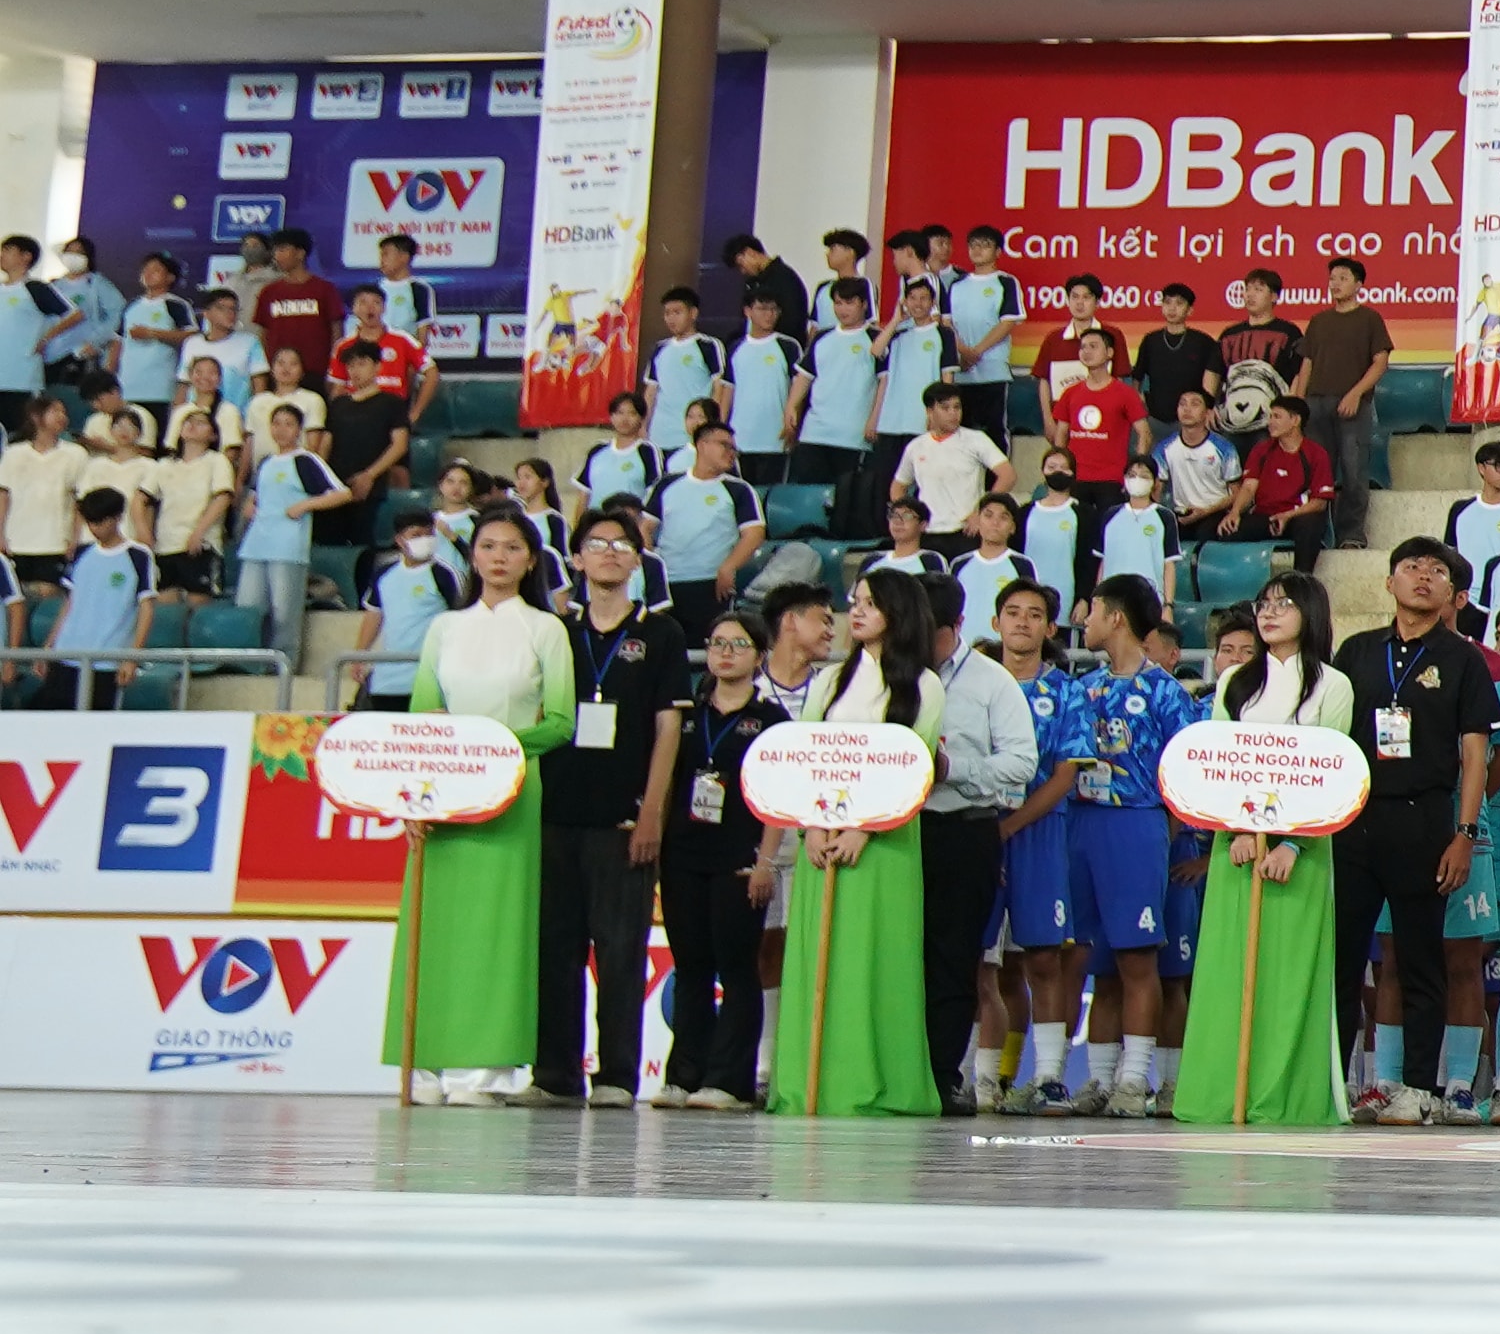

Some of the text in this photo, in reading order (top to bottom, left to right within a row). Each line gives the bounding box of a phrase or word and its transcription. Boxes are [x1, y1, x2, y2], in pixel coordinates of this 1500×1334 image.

[1003, 114, 1457, 209] HDBank
[368, 170, 486, 213] VOV
[544, 224, 615, 246] HDBank
[1003, 226, 1382, 263] Cam kết lợi ích cao
[391, 721, 455, 738] TRƯỜNG
[811, 731, 869, 746] TRƯỜNG
[1234, 731, 1298, 748] TRƯỜNG
[324, 739, 520, 758] ĐẠI HỌC SWINBURNE VIETNAM
[760, 749, 918, 769] ĐẠI HỌC CÔNG NGHIỆP
[354, 758, 486, 775] ALLIANCE PROGRAM
[1187, 749, 1344, 771] ĐẠI HỌC NGOẠI NGỮ
[811, 770, 861, 781] TP.HCM
[1202, 768, 1323, 787] TIN HỌC TP.HCM
[1464, 892, 1491, 920] 14
[1139, 906, 1156, 933] 4
[139, 935, 352, 1016] VOV
[156, 1026, 293, 1049] GIAO THÔNG
